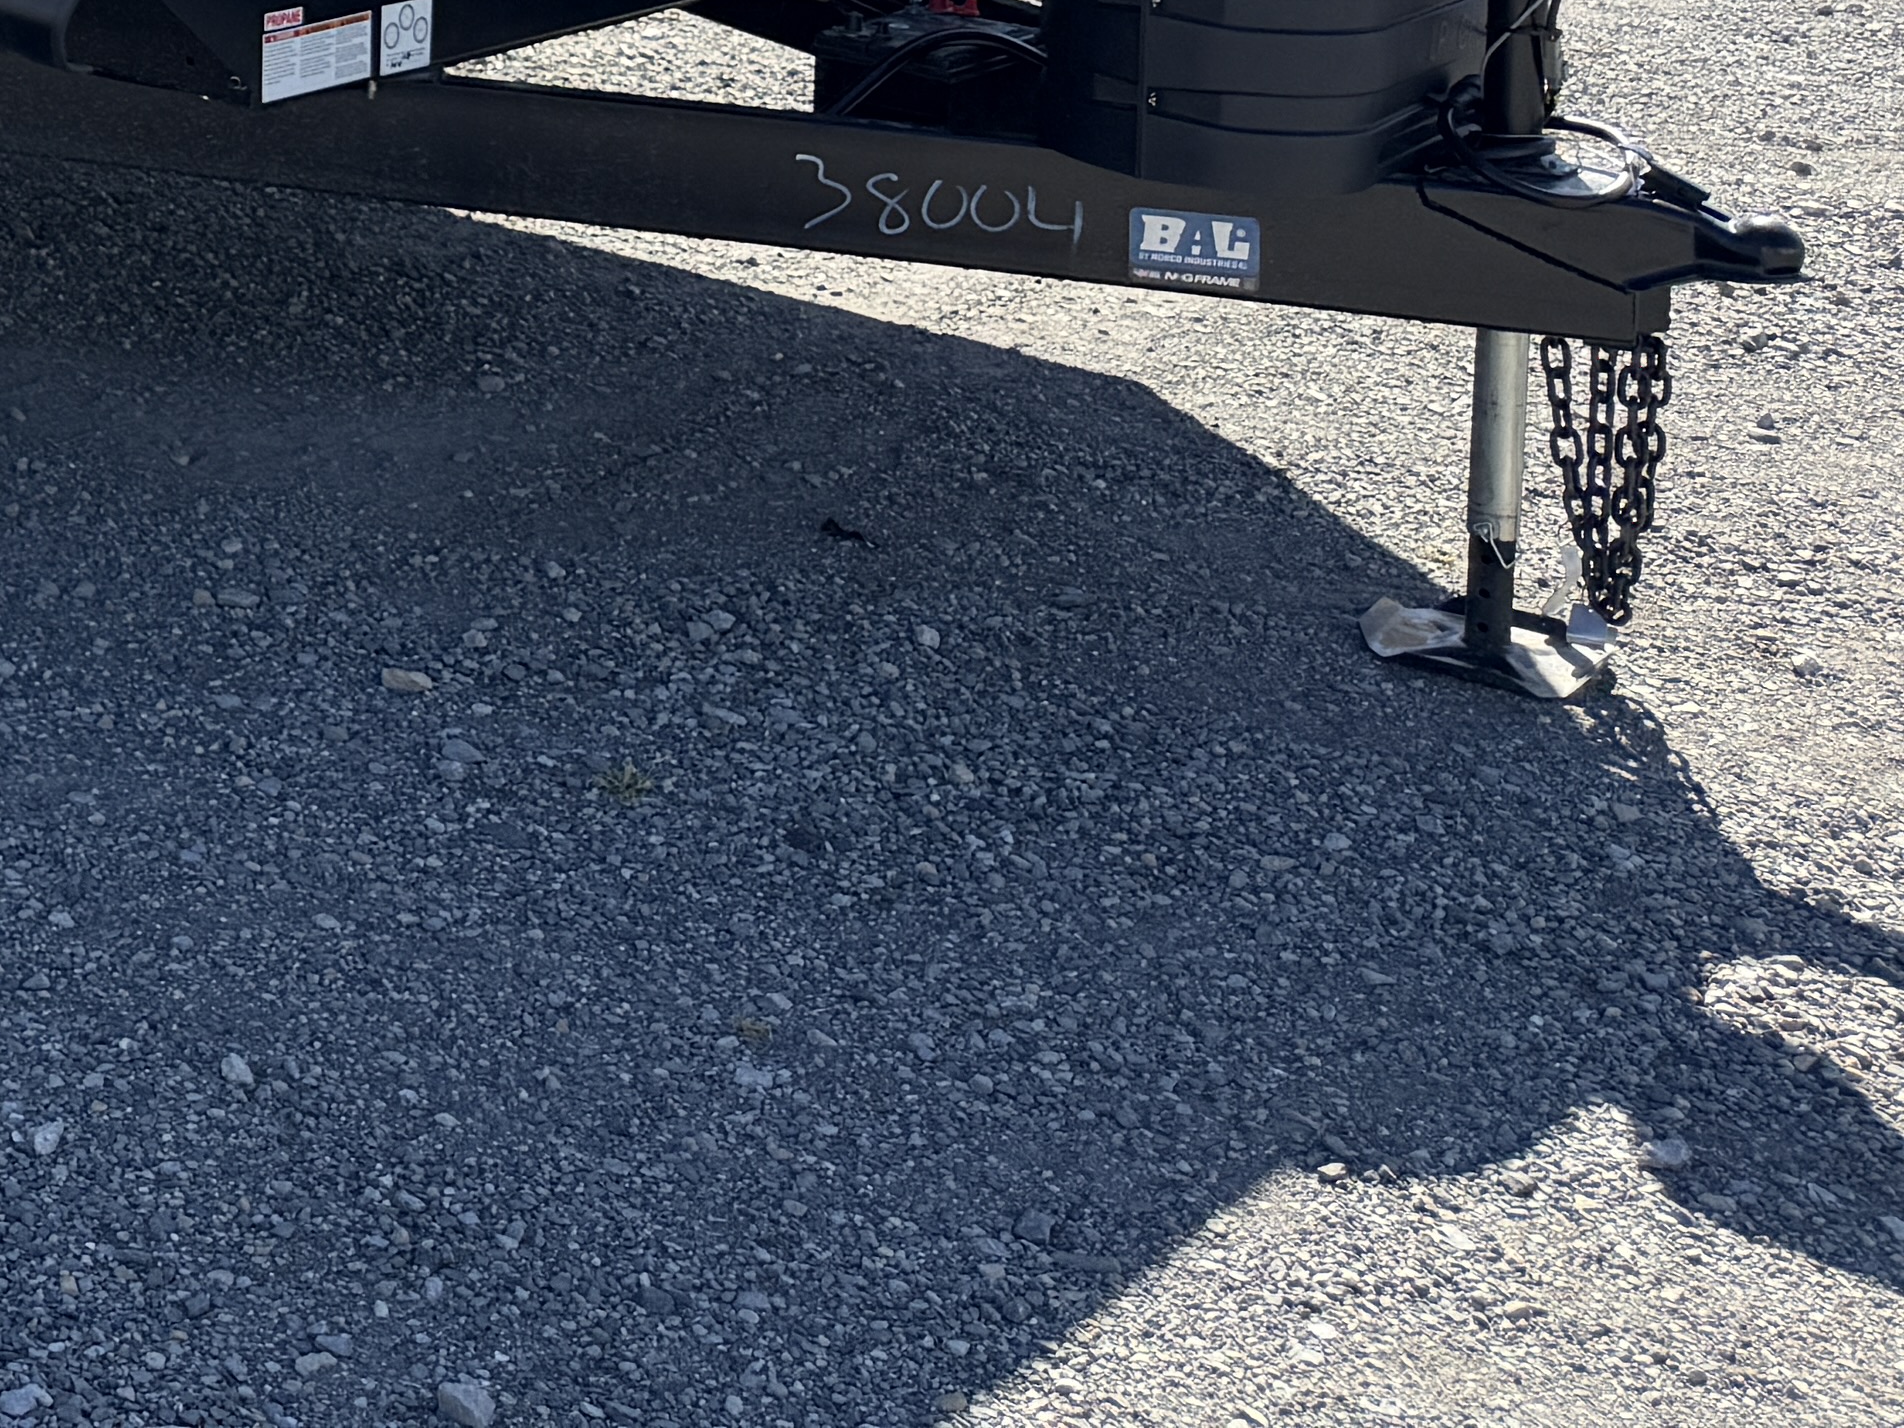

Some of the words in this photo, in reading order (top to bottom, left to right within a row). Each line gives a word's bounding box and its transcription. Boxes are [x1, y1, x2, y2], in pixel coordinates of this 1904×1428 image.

[795, 154, 1083, 248] 38004
[1140, 214, 1250, 260] BAL
[1184, 256, 1236, 269] INDUSTRIES
[1194, 274, 1241, 288] FRAME
